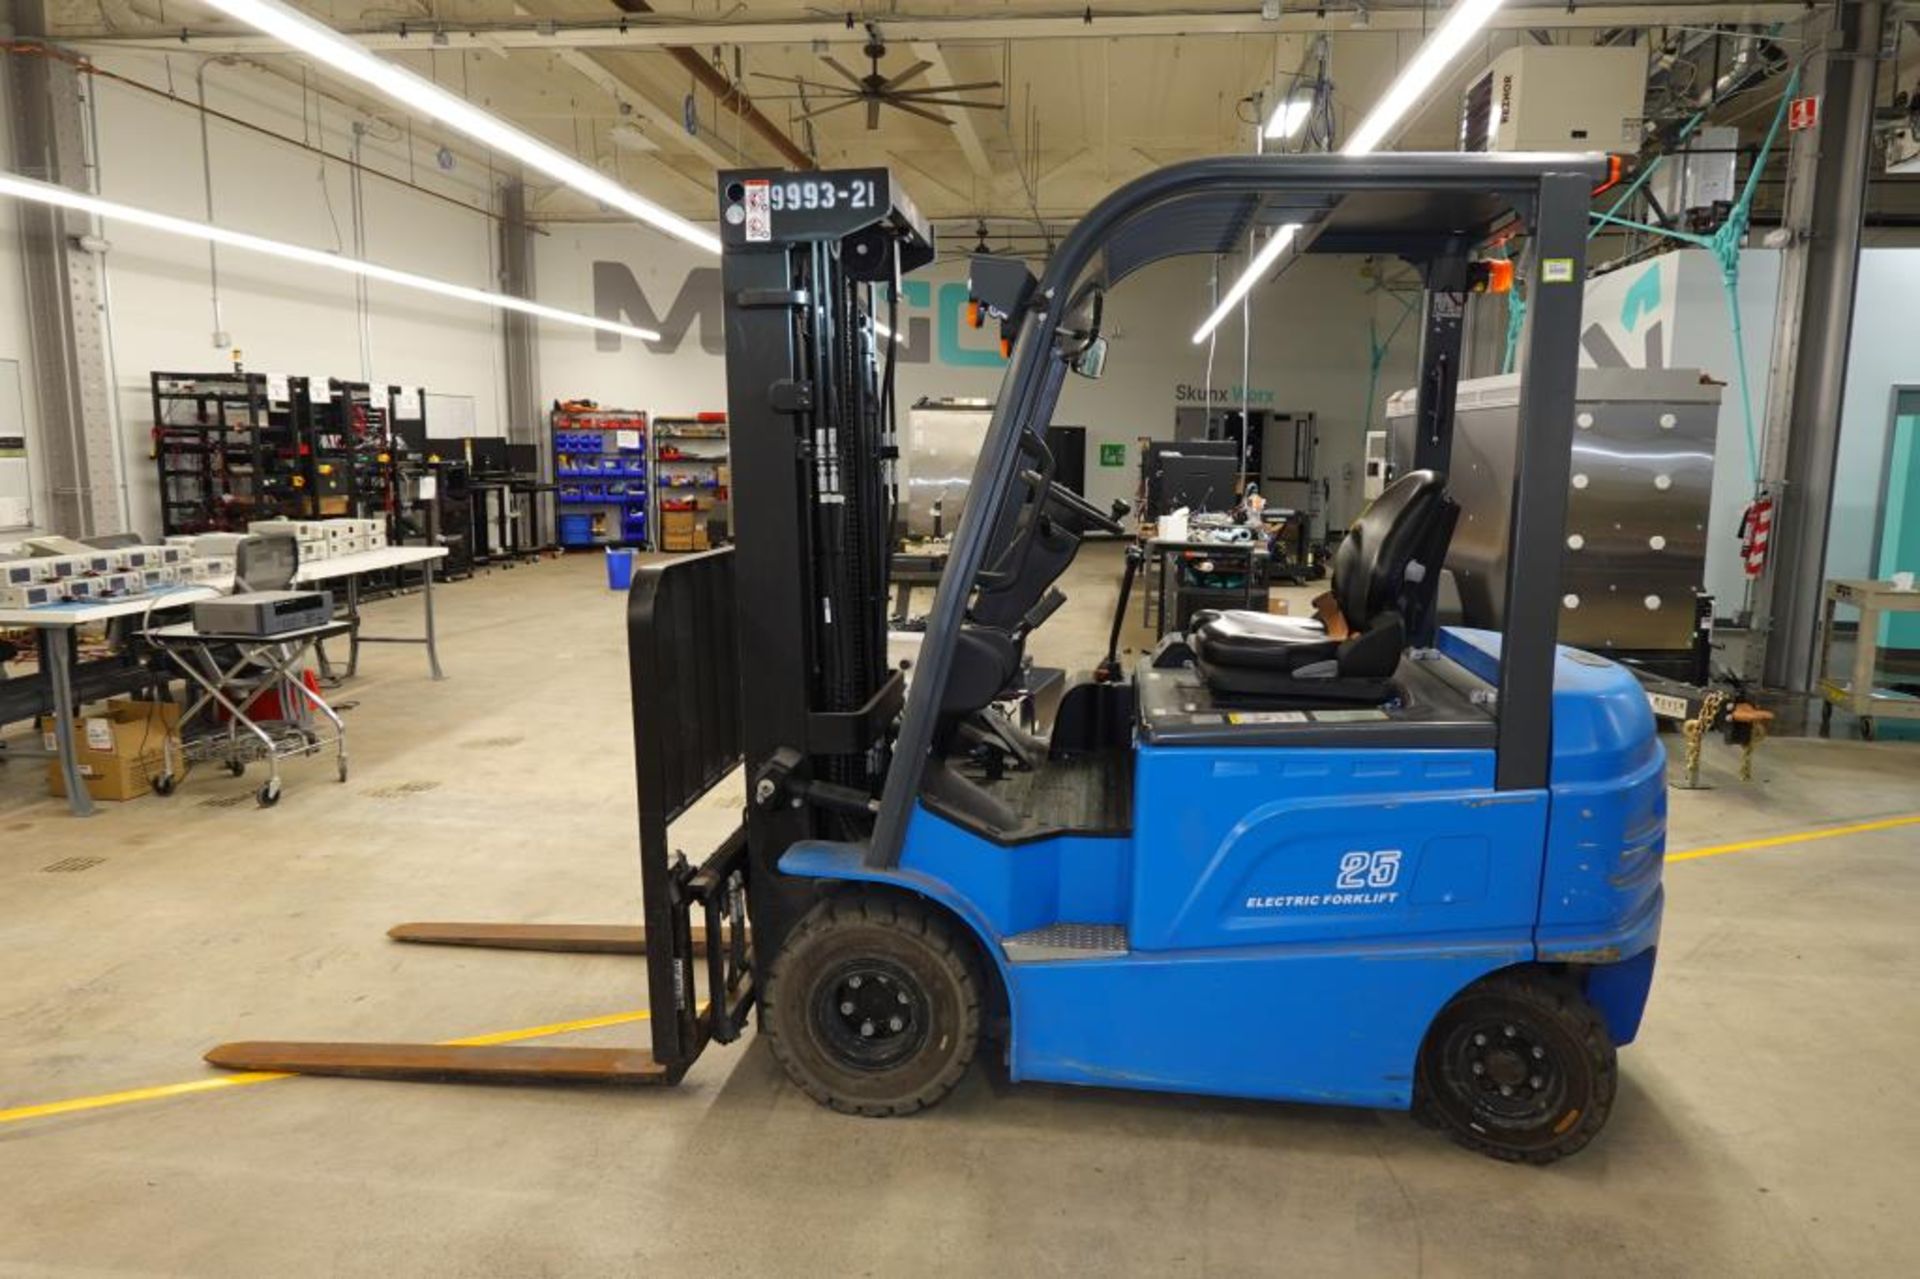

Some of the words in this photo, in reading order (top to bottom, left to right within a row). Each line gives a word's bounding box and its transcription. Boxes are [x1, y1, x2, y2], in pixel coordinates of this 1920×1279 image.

[771, 180, 875, 211] 9993-21
[1175, 384, 1229, 402] Skunx
[1231, 385, 1275, 403] Worx
[1336, 850, 1402, 889] 25
[1246, 896, 1320, 909] ELECTRIC
[1322, 891, 1399, 905] FORKLIFT
